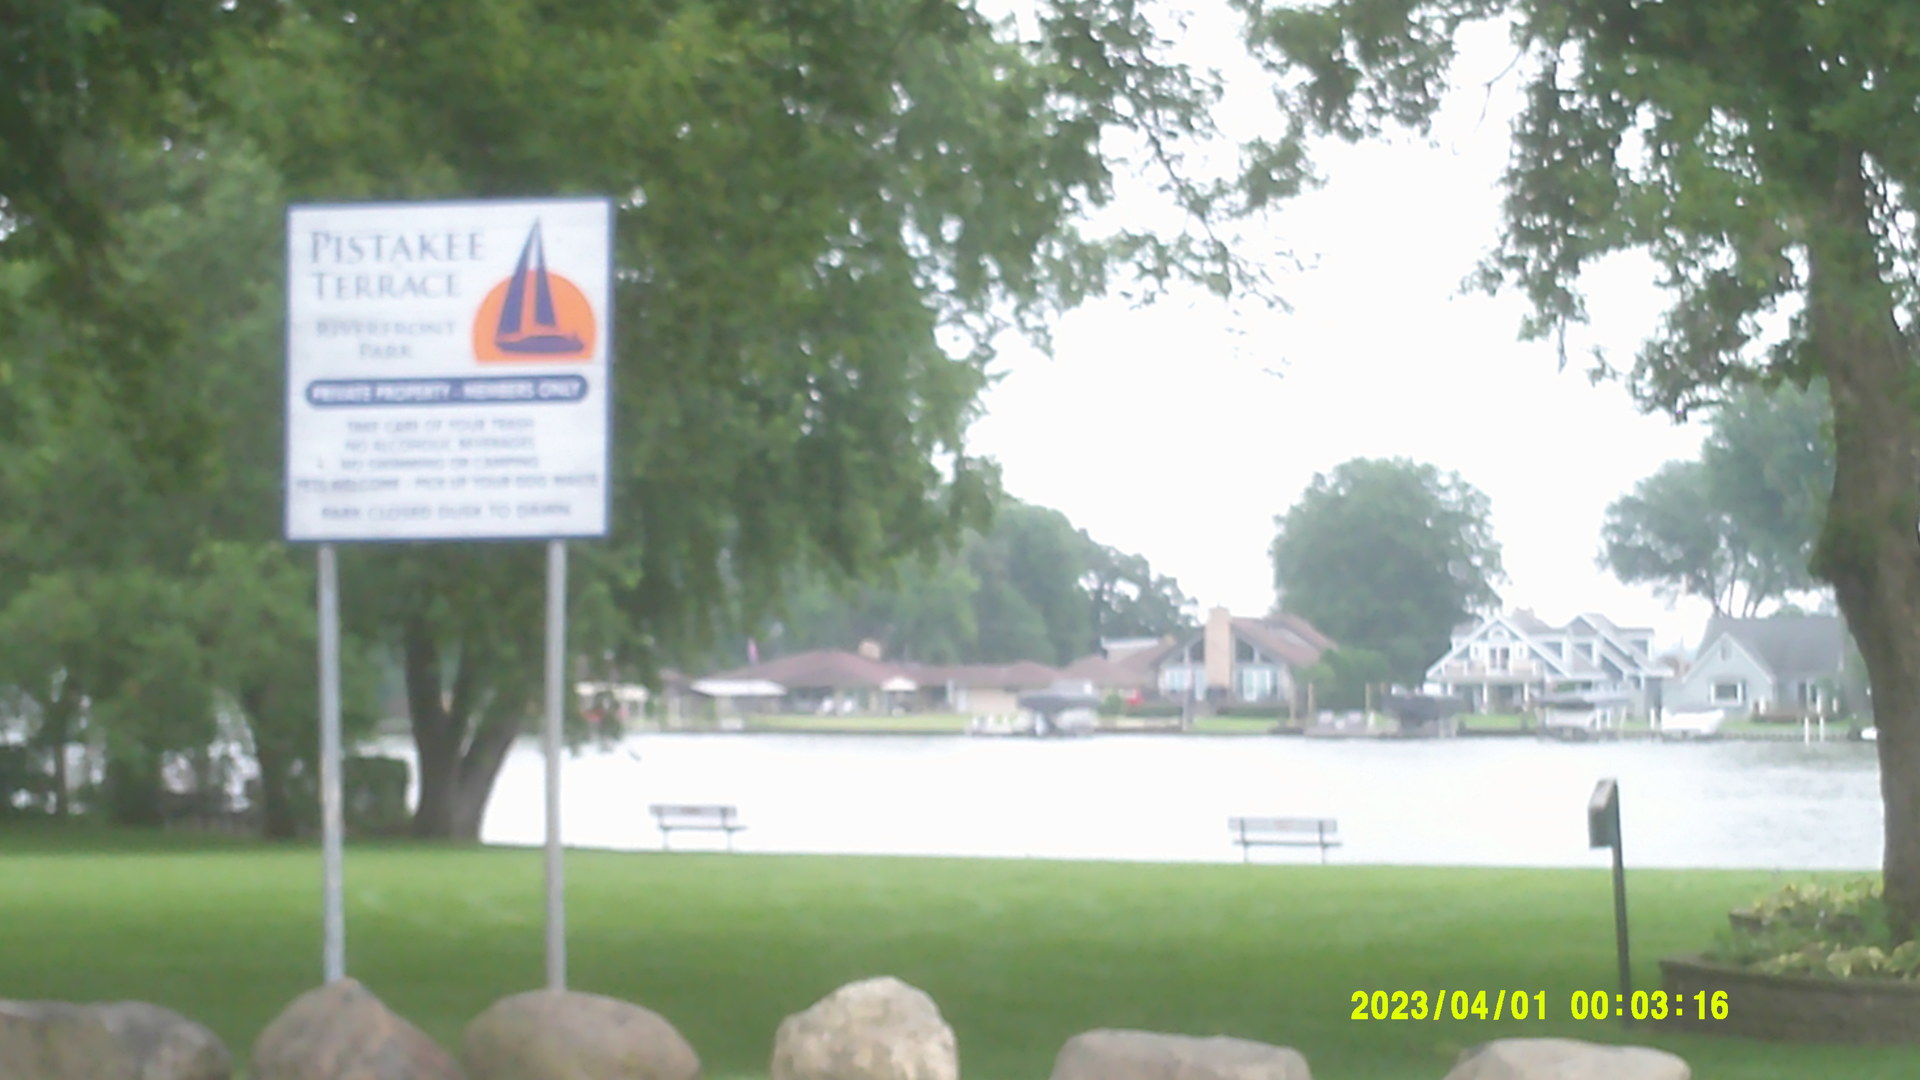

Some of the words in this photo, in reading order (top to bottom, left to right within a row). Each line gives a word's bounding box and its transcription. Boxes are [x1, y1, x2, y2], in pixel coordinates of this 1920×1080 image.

[310, 229, 486, 264] PISTAKEE
[311, 271, 462, 300] TERRACE
[358, 342, 414, 360] PARK
[376, 383, 451, 401] PROPERTY
[538, 380, 582, 398] ONLY
